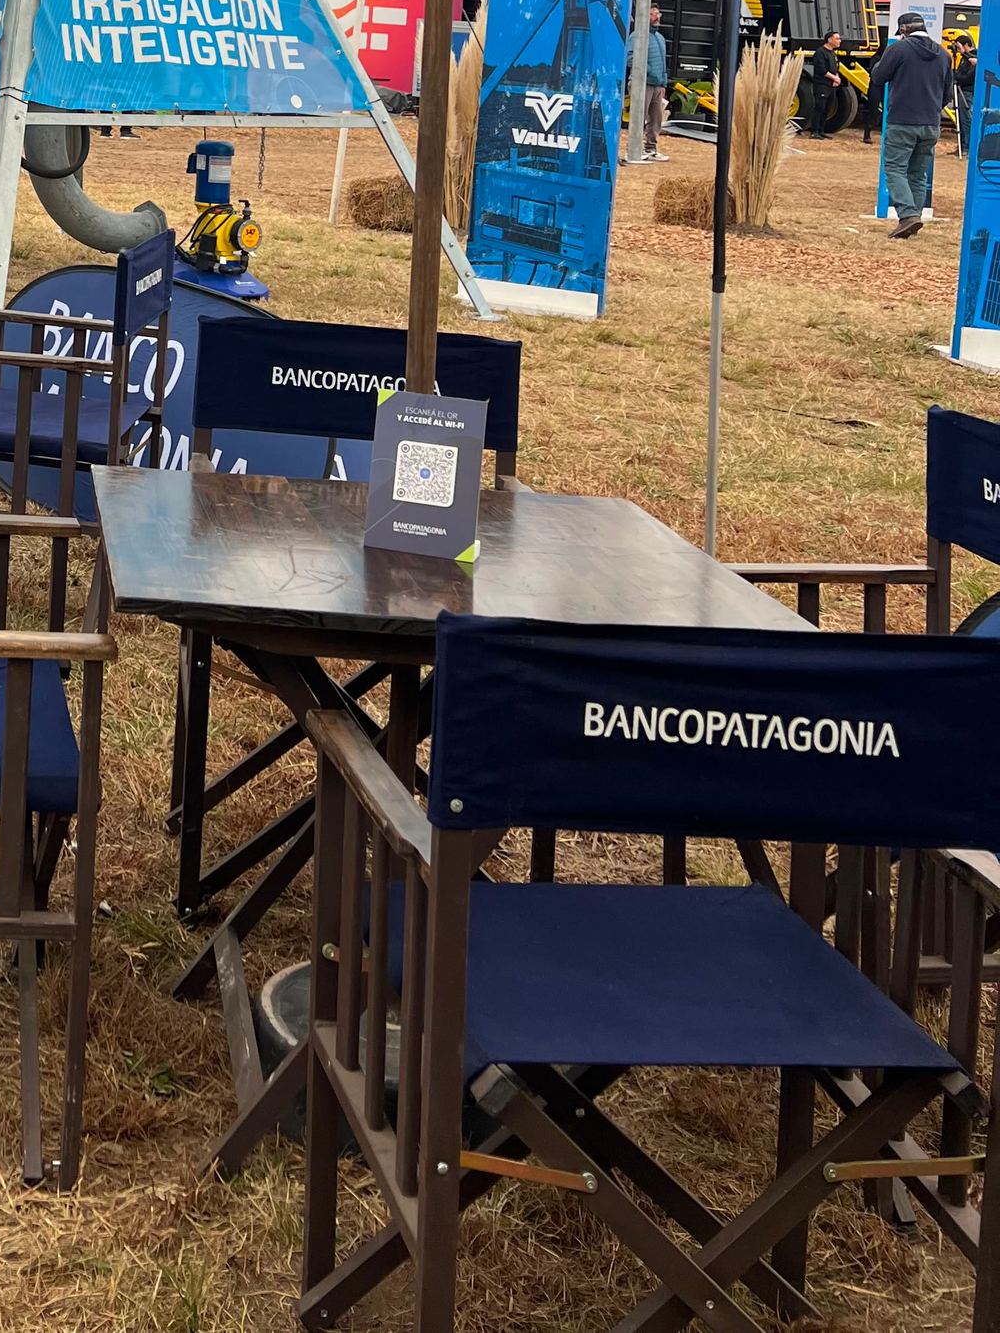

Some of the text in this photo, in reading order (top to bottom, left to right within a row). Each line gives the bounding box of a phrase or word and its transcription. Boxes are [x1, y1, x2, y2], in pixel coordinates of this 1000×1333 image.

[61, 22, 306, 71] INTELIGENTE
[511, 127, 582, 153] VALLEY
[403, 415, 432, 426] ACCEDÉ
[433, 419, 444, 427] AL
[444, 420, 465, 429] WI-FI
[404, 406, 436, 418] ESCANEÁ
[437, 410, 446, 418] EL
[583, 701, 900, 758] BANCOPATAGONIA
